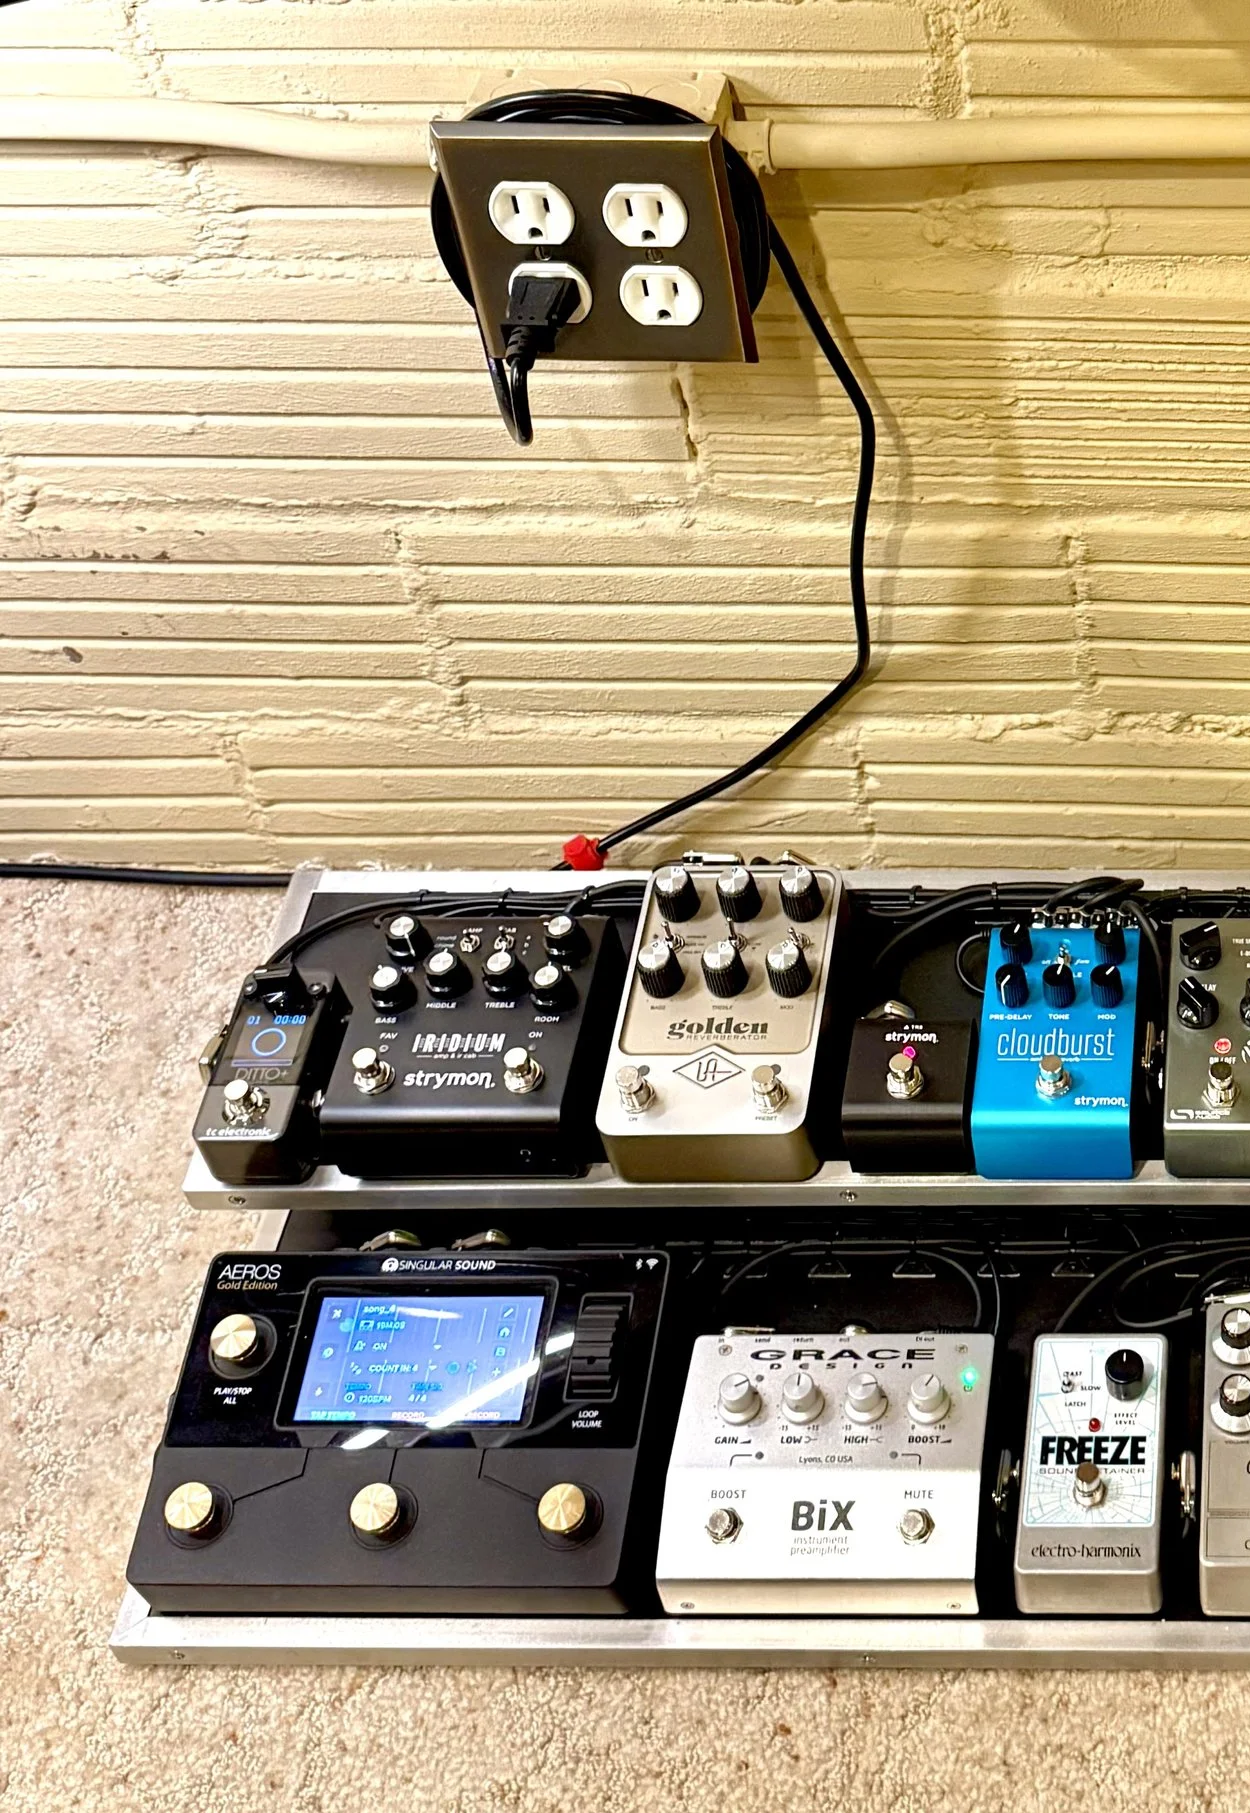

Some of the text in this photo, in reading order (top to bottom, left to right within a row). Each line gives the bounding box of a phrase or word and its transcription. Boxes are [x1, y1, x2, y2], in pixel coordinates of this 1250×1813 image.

[274, 1014, 307, 1025] 00:00
[666, 1017, 769, 1040] golden
[412, 1033, 506, 1053] IRIDIUM
[997, 1028, 1115, 1056] cloudburst
[206, 1127, 272, 1137] tc electronic
[399, 1260, 496, 1271] SINGULAR SOUND
[218, 1264, 282, 1279] AEROS
[216, 1280, 278, 1290] Gold Edition
[750, 1348, 936, 1361] GRACE
[213, 1387, 253, 1395] PLAY/STOP
[578, 1410, 599, 1418] LOOP
[572, 1420, 602, 1428] VOLUME
[714, 1436, 738, 1444] GAIN
[781, 1435, 802, 1444] LOW
[843, 1435, 868, 1444] HIGH
[908, 1435, 940, 1444] BOOST
[1039, 1435, 1147, 1465] FREEZE
[799, 1455, 822, 1464] Lyons,
[837, 1455, 853, 1463] USA
[711, 1489, 747, 1499] BOOST
[904, 1490, 934, 1499] MUTE
[791, 1499, 856, 1531] BiX
[794, 1536, 848, 1544] instrument
[790, 1546, 850, 1556] preamplifier
[1032, 1543, 1141, 1559] electro-harmonix
